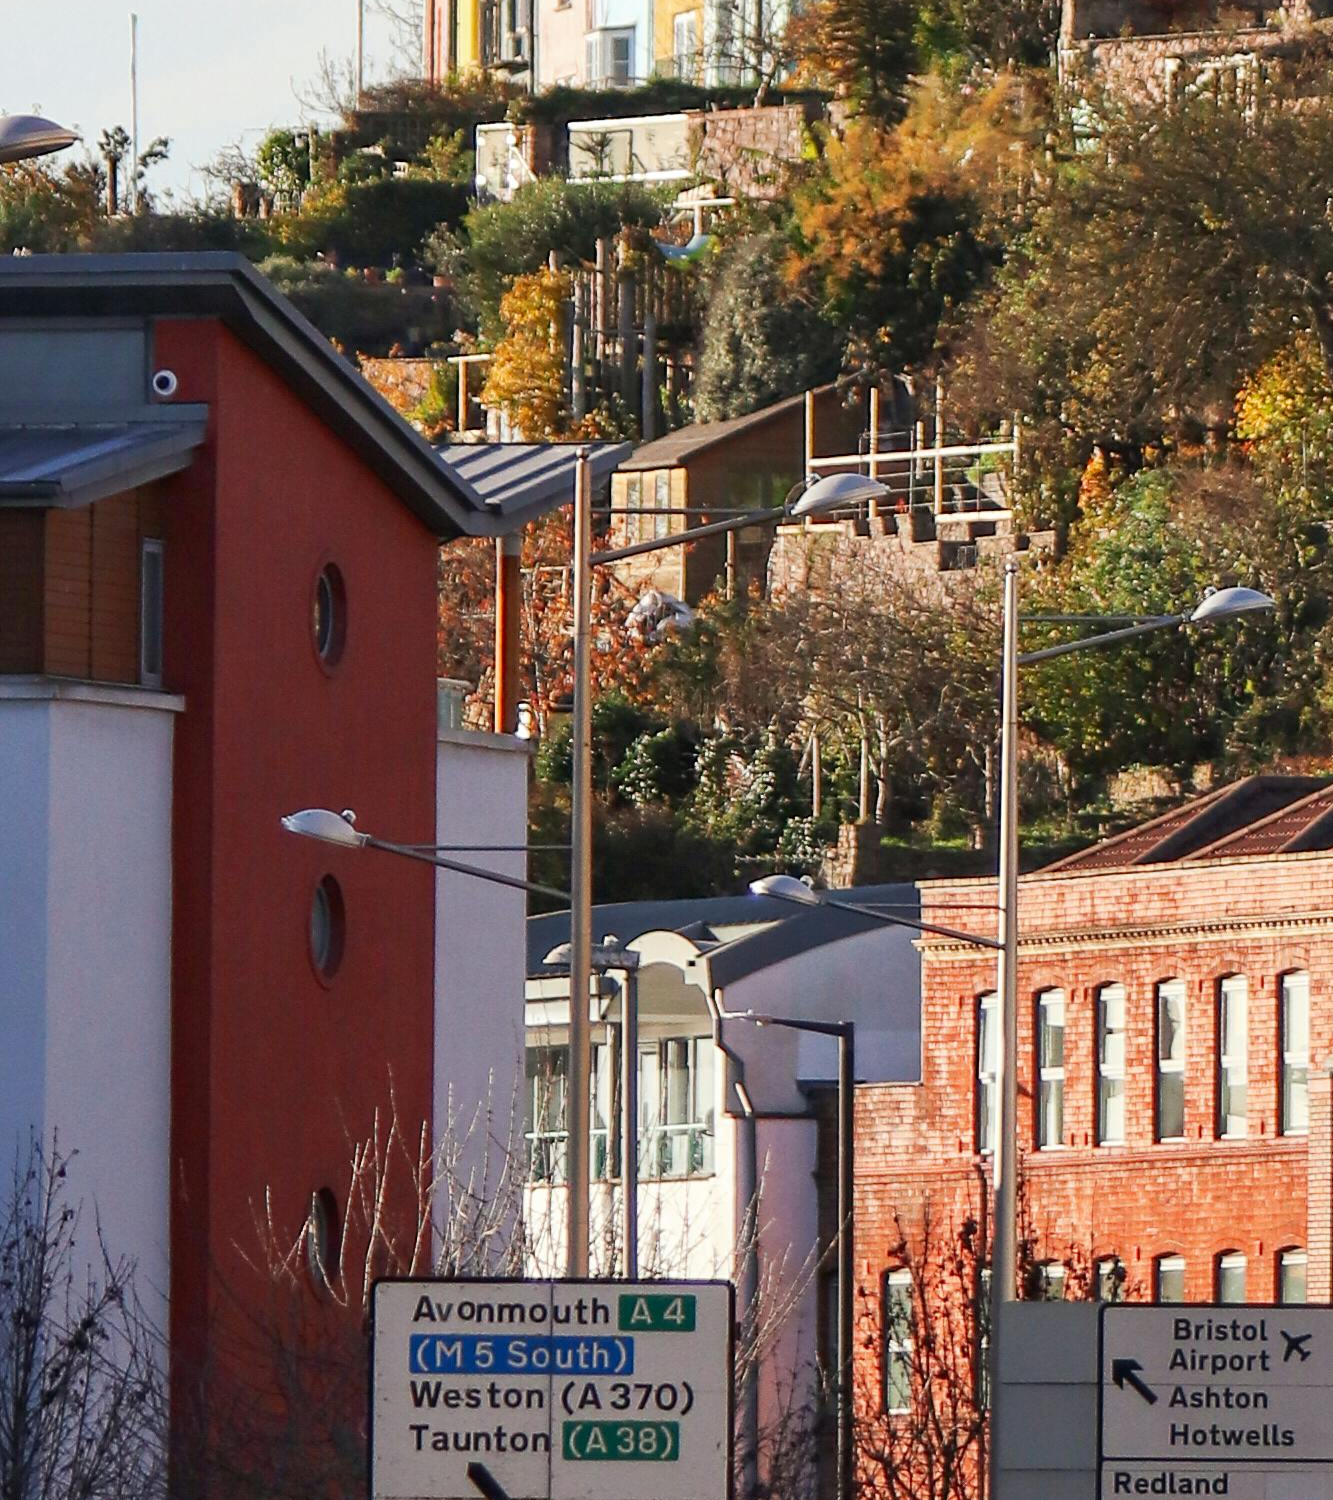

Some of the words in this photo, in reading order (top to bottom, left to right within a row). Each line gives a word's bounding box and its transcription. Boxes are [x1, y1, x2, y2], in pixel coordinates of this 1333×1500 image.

[412, 1295, 609, 1325] Avonmouth
[1174, 1318, 1268, 1341] Bristol
[508, 1340, 627, 1373] South)
[1169, 1348, 1270, 1375] Airport
[410, 1380, 544, 1409] Weston
[1169, 1386, 1268, 1409] Ashton
[409, 1424, 550, 1452] Taunton
[1170, 1424, 1295, 1446] Hotwells
[1114, 1471, 1229, 1495] Redland
